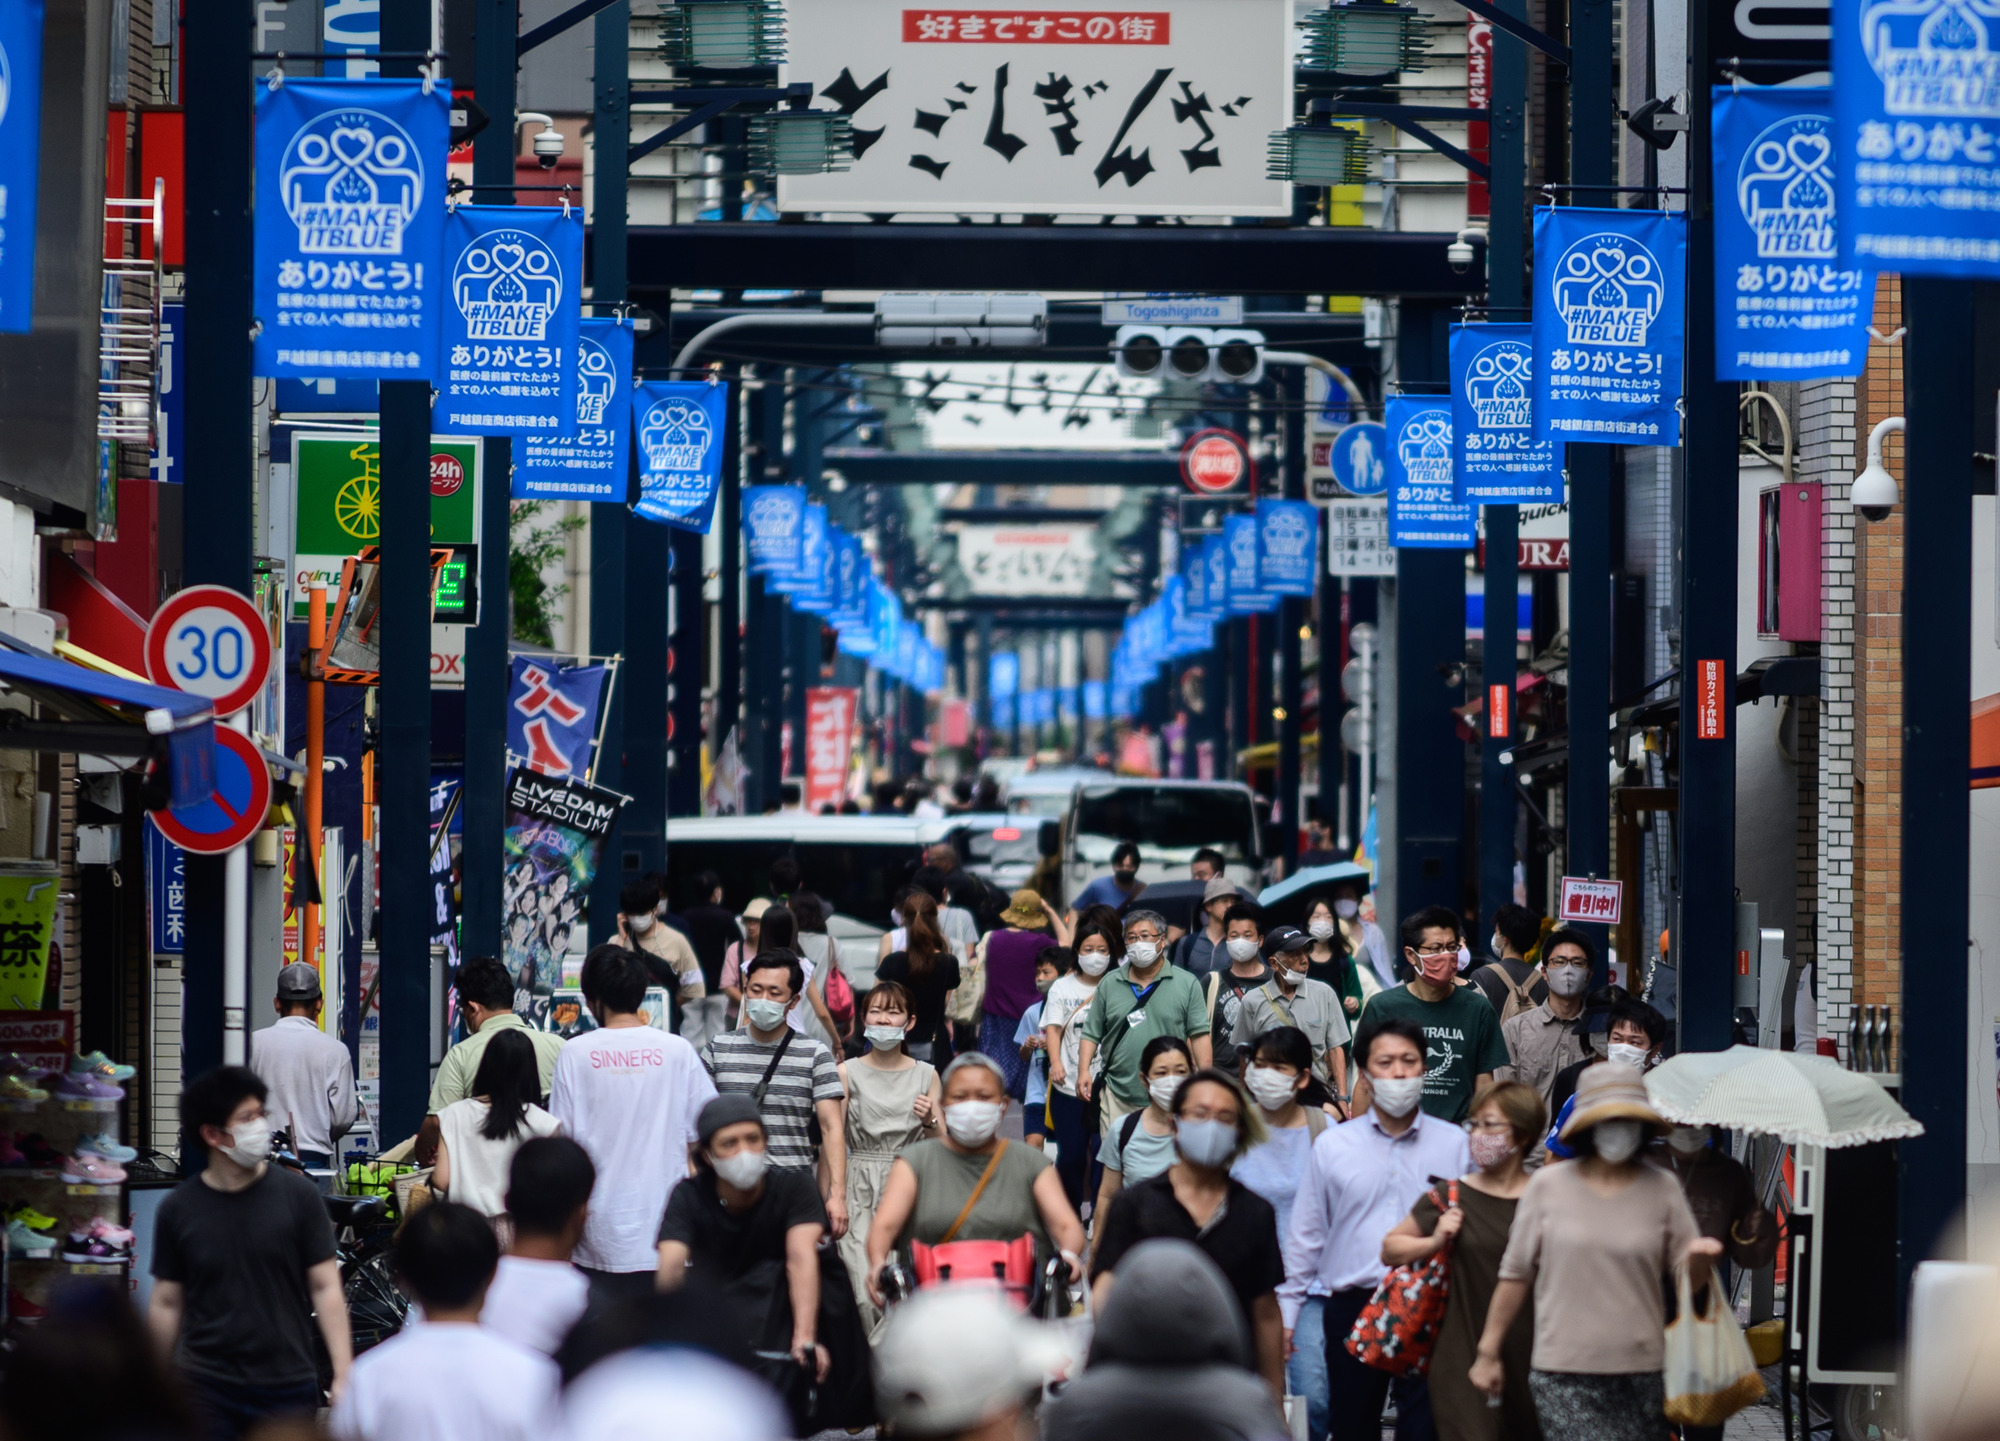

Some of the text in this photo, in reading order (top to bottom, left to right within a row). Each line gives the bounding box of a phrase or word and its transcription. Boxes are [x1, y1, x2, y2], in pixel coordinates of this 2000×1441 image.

[918, 16, 1156, 41] 好きですこの街
[820, 62, 1254, 189] とごしぎんざ
[1856, 119, 2000, 163] ありがと
[304, 209, 397, 226] #MAKE
[304, 228, 393, 248] ITBLUE
[277, 259, 424, 290] ありがとう!
[470, 304, 544, 321] #MAKE
[1125, 304, 1219, 319] Togoshiginza
[1571, 308, 1645, 326] #MAKE
[471, 321, 539, 336] ITBLUE
[1572, 325, 1641, 342] ITBLUE
[450, 345, 561, 368] ありがとう!
[1551, 349, 1662, 374] ありがとう!
[450, 370, 560, 382] 医療の最前線でたたかう
[1551, 375, 1661, 389] 医療の最前線でたたかう
[450, 384, 560, 397] 全ての人へ感謝を込めて
[1550, 389, 1661, 403] 全ての人へ感謝を込めて
[449, 414, 559, 428] 戸越銀座商店街連合会
[1550, 419, 1659, 435] 戸越銀座商店街連合会
[526, 447, 614, 458] 医療の最前線でたたかう
[1465, 453, 1553, 462] 医療の最前線でたたかう
[526, 458, 614, 470] 全ての人へ感謝を込めて
[653, 458, 697, 468] ITBLUE
[1466, 463, 1552, 472] 全ての人へ感謝を込めて
[430, 479, 460, 488] ープン
[526, 481, 612, 494] 戸越銀座商店街連合会
[640, 473, 711, 489] ありがとう!
[1466, 486, 1553, 496] 戸越銀座商店街連合会
[177, 626, 243, 680] 30
[1706, 661, 1717, 737] 防犯カメラ作動中
[515, 776, 614, 819] LIVEDAM
[511, 791, 609, 834] STADIUM
[1572, 884, 1612, 892] こちらのコーナー
[1567, 893, 1616, 915] 値引中!
[590, 1048, 663, 1069] SINNERS
